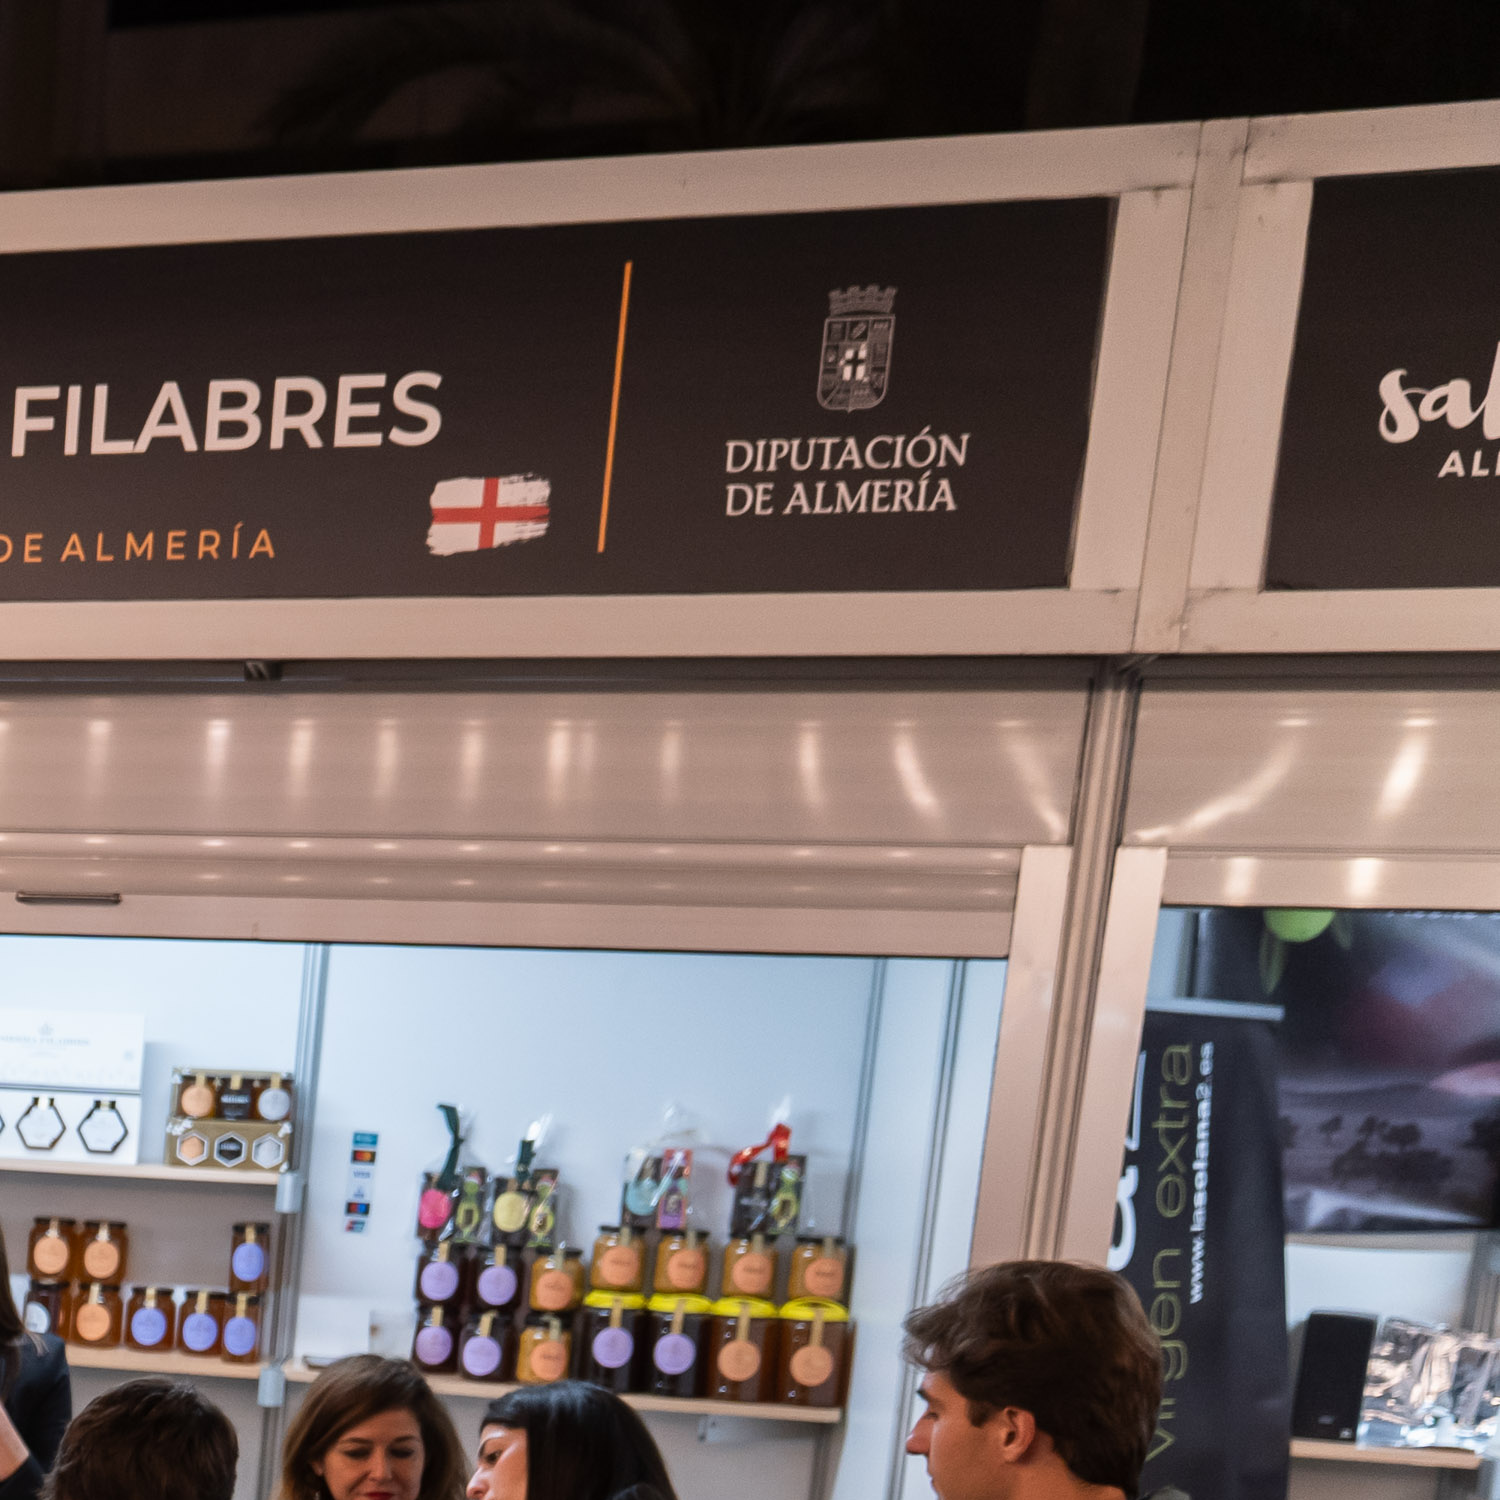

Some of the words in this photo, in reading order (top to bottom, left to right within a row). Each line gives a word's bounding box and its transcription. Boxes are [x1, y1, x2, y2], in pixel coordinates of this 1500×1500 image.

[10, 371, 443, 458] FILABRES
[725, 426, 969, 474] DIPUTACIÓN
[1437, 449, 1500, 478] AL
[725, 482, 774, 516] DE
[782, 473, 958, 516] ALMERÍA
[60, 522, 276, 564] ALMERÍA
[1152, 1044, 1193, 1218] extra
